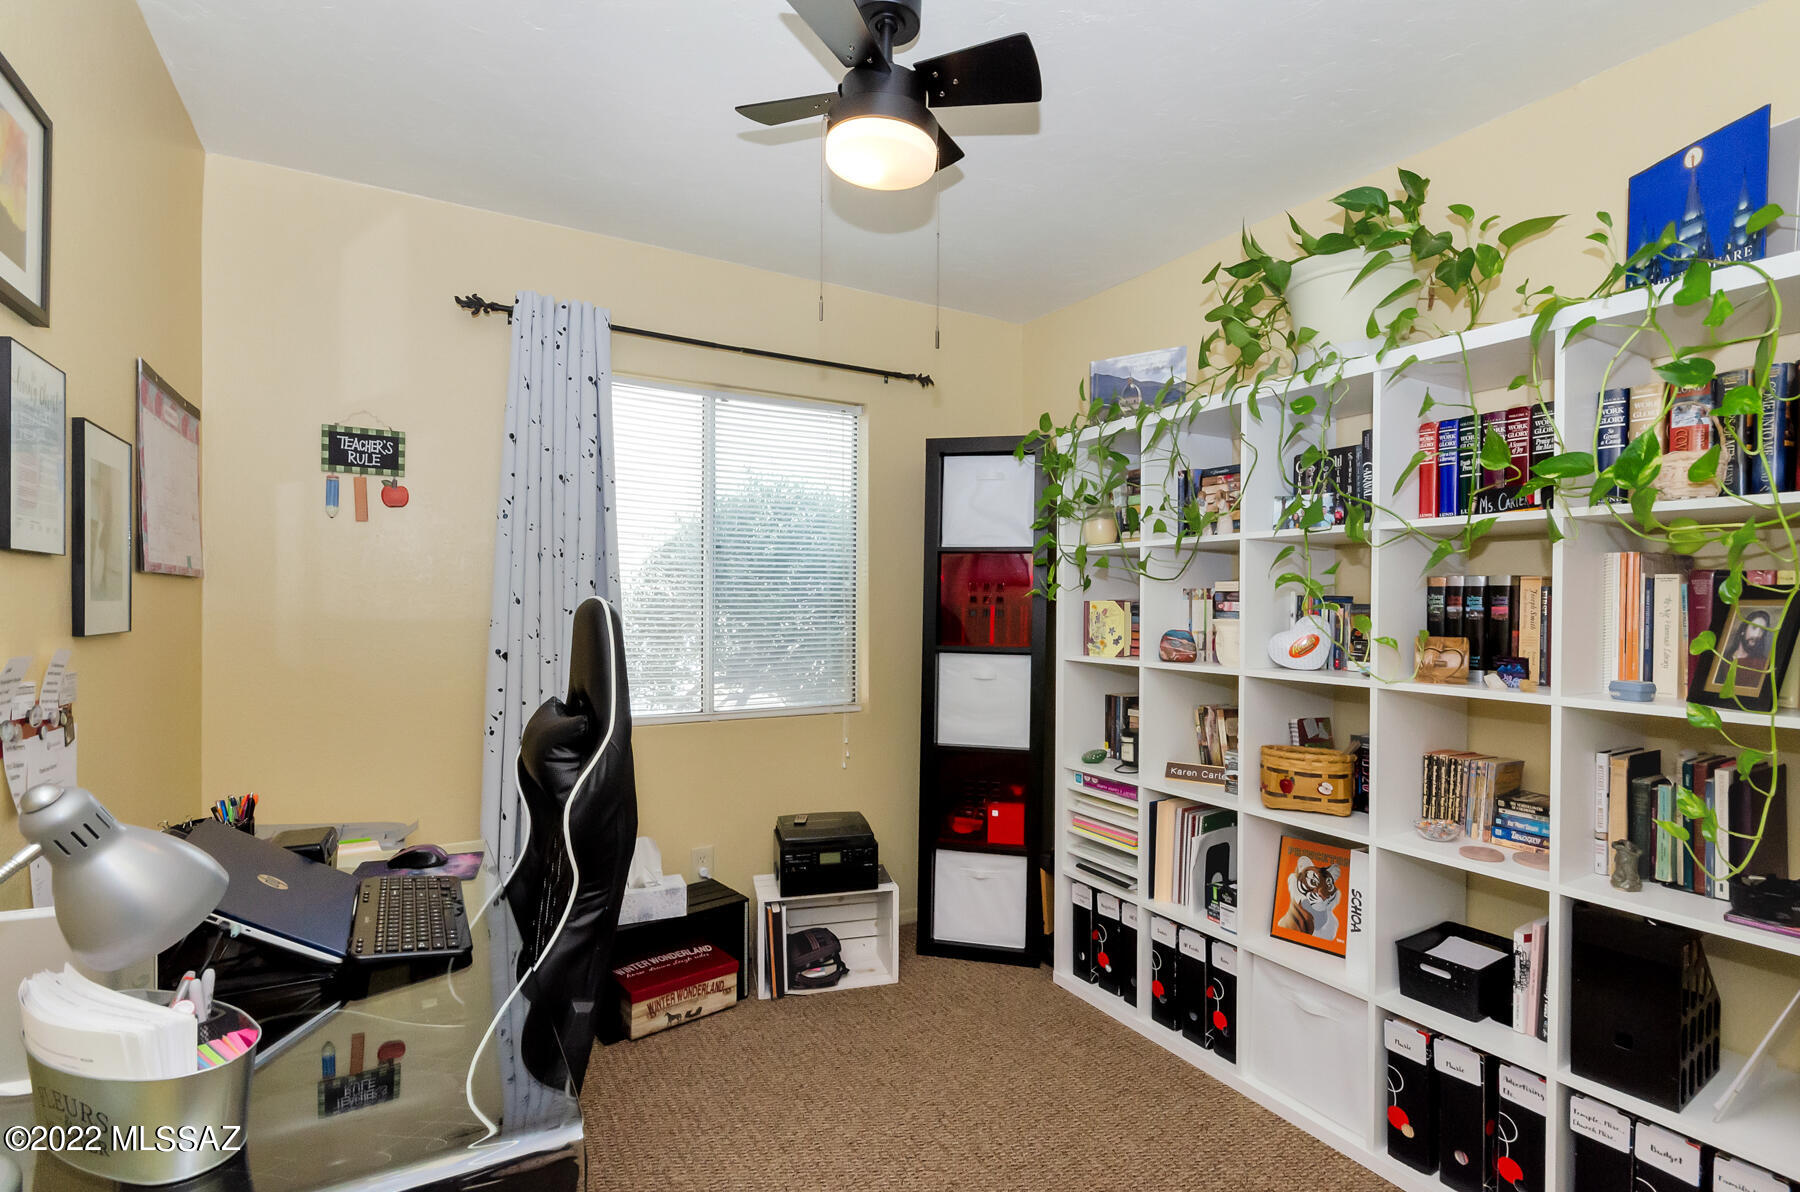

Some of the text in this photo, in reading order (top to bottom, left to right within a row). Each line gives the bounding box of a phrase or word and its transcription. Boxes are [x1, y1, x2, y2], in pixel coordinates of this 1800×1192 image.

[337, 436, 393, 455] TEACHER'S
[348, 451, 381, 466] RULE
[1480, 496, 1496, 513] Ms.
[1170, 767, 1197, 777] Karen
[1351, 888, 1362, 933] SCHOA
[613, 944, 713, 976] WINTER WONDERLAND
[646, 980, 725, 1017] WINTER WONDERLAND
[1650, 1144, 1682, 1164] Budget
